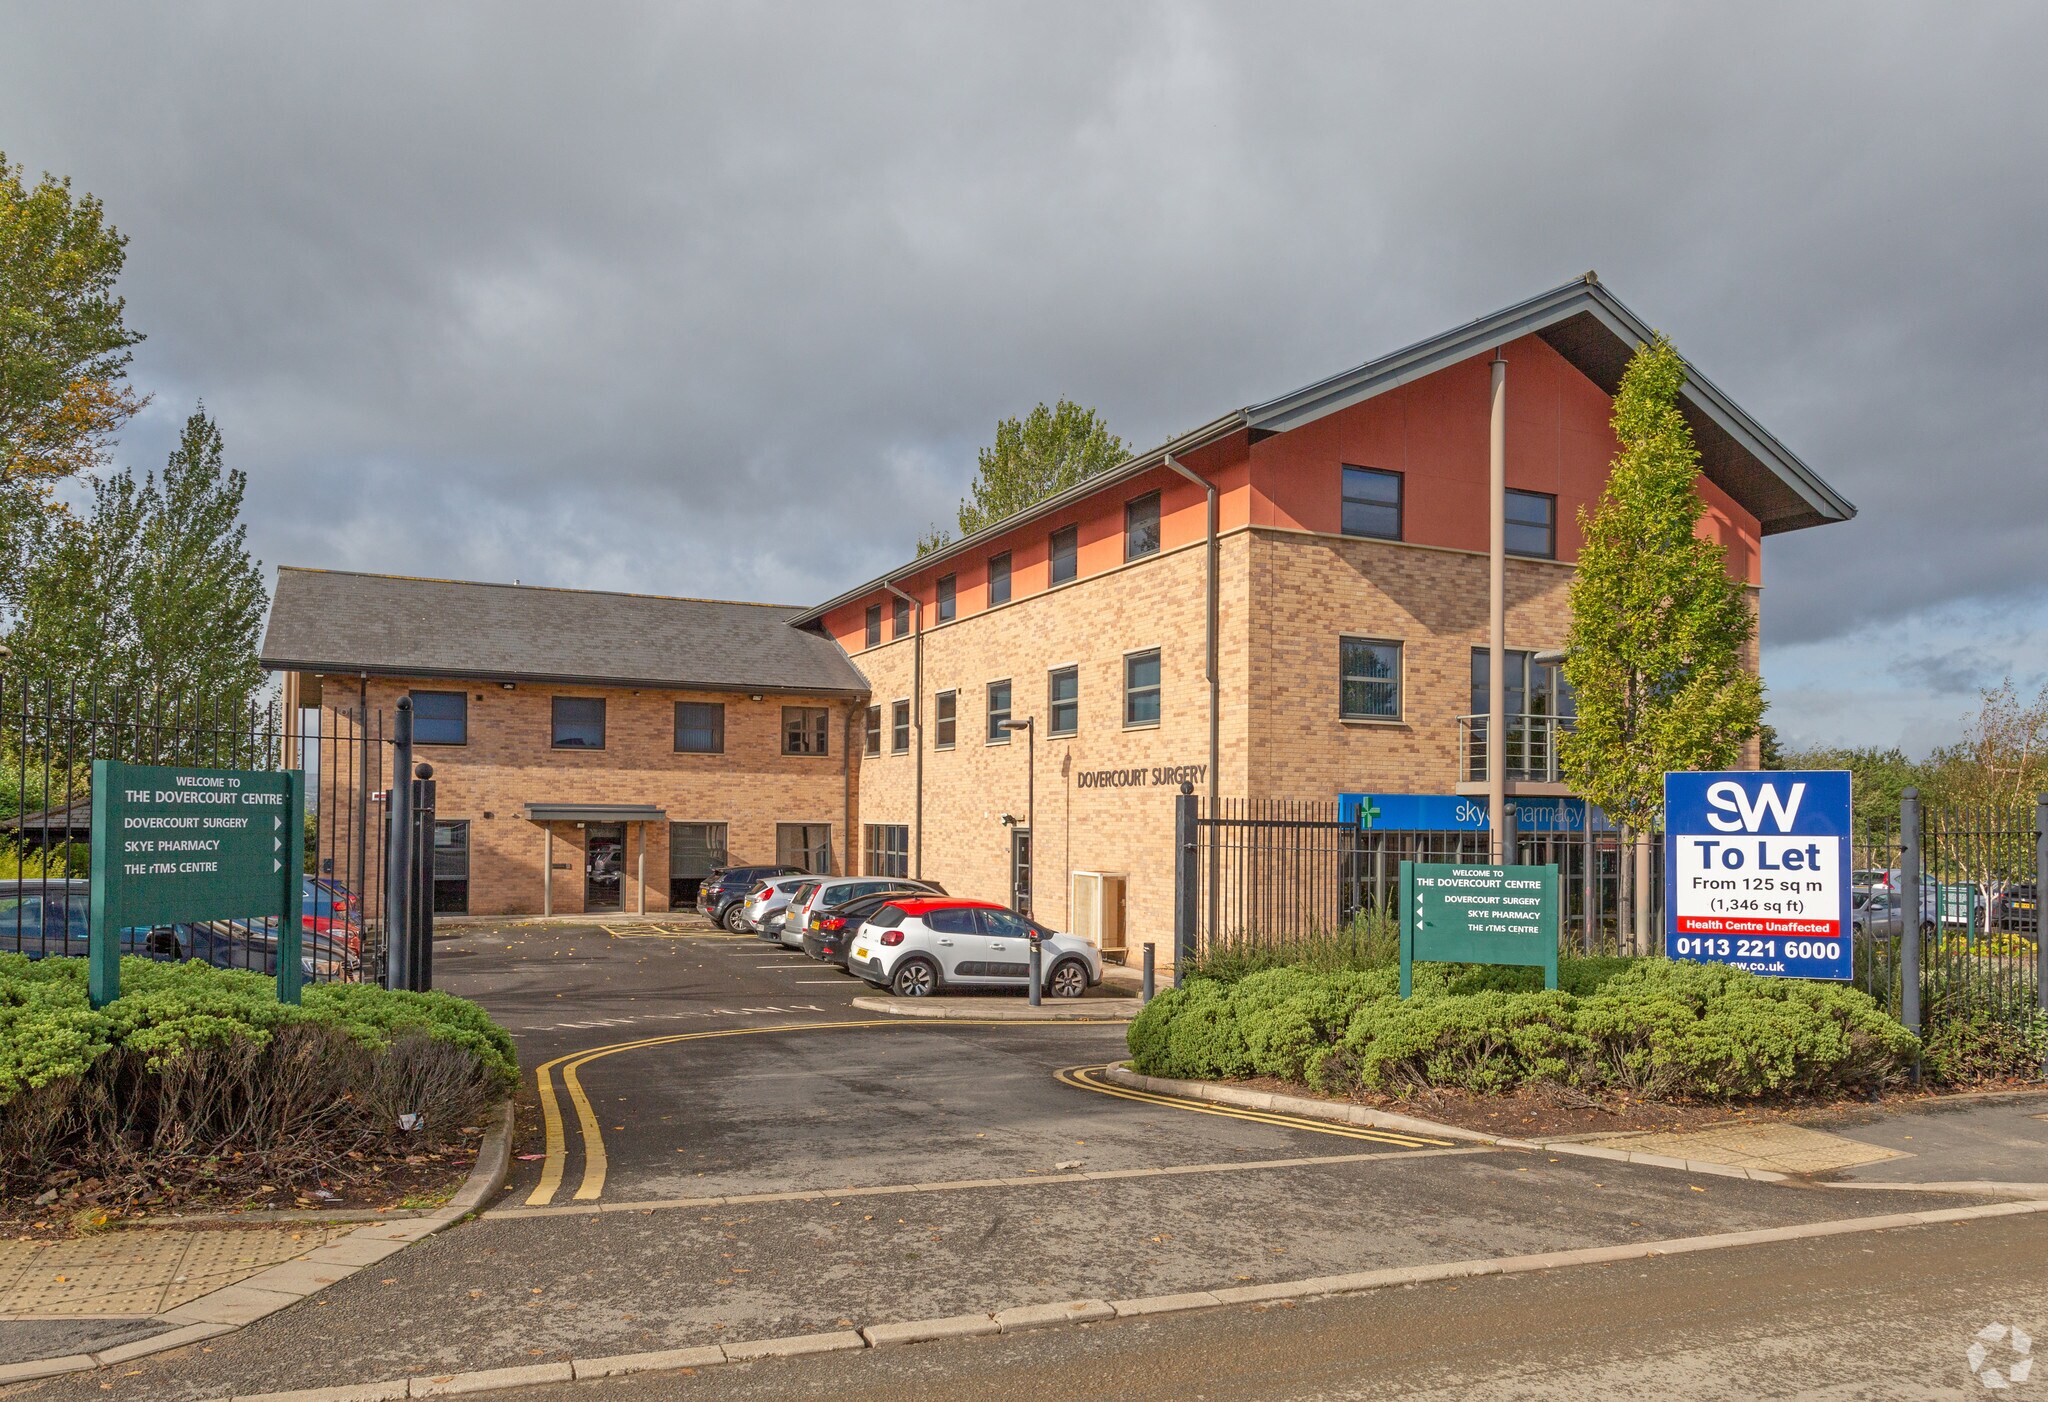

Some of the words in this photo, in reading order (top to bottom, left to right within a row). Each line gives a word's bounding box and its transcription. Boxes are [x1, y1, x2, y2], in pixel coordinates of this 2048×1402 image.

[176, 776, 224, 788] WELCOME
[227, 777, 241, 788] TO
[1077, 767, 1149, 789] DOVERCOURT
[1151, 764, 1208, 787] SURGERY
[125, 790, 150, 803] THE
[155, 791, 238, 804] DOVERCOURT
[241, 792, 283, 805] CENTRE
[1455, 800, 1490, 827] sky
[1514, 802, 1584, 827] harmacy
[1706, 781, 1806, 833] SW
[124, 817, 200, 829] DOVERCOURT
[203, 817, 249, 828] SURGERY
[124, 840, 154, 852] SKYE
[158, 839, 220, 852] PHARMACY
[1693, 840, 1745, 870] To
[1758, 841, 1821, 871] Let
[124, 863, 146, 875] THE
[149, 862, 177, 874] rTMS
[179, 861, 218, 873] CENTRE
[1452, 869, 1491, 877] WELCOME
[1493, 870, 1504, 878] TO
[1416, 878, 1435, 887] THE
[1437, 878, 1502, 888] DOVERCOURT
[1504, 880, 1541, 889] CENTRE
[1692, 876, 1736, 890] From
[1743, 878, 1774, 891] 125
[1780, 880, 1801, 894] sq
[1806, 881, 1822, 892] m
[1444, 895, 1500, 904] DOVERCOURT
[1502, 897, 1541, 906] SURGERY
[1710, 898, 1759, 913] (1,346
[1763, 902, 1782, 914] sq
[1786, 899, 1804, 915] ft)
[1467, 910, 1489, 918] SKYE
[1491, 911, 1541, 920] PHARMACY
[1468, 924, 1484, 932] THE
[1485, 924, 1506, 933] rTMS
[1508, 925, 1539, 934] CENTRE
[1686, 919, 1723, 930] Health
[1725, 921, 1763, 932] Centre
[1765, 922, 1830, 933] Unaffected
[1677, 937, 1730, 956] 0113
[1736, 939, 1775, 958] 221
[1784, 941, 1841, 960] 6000
